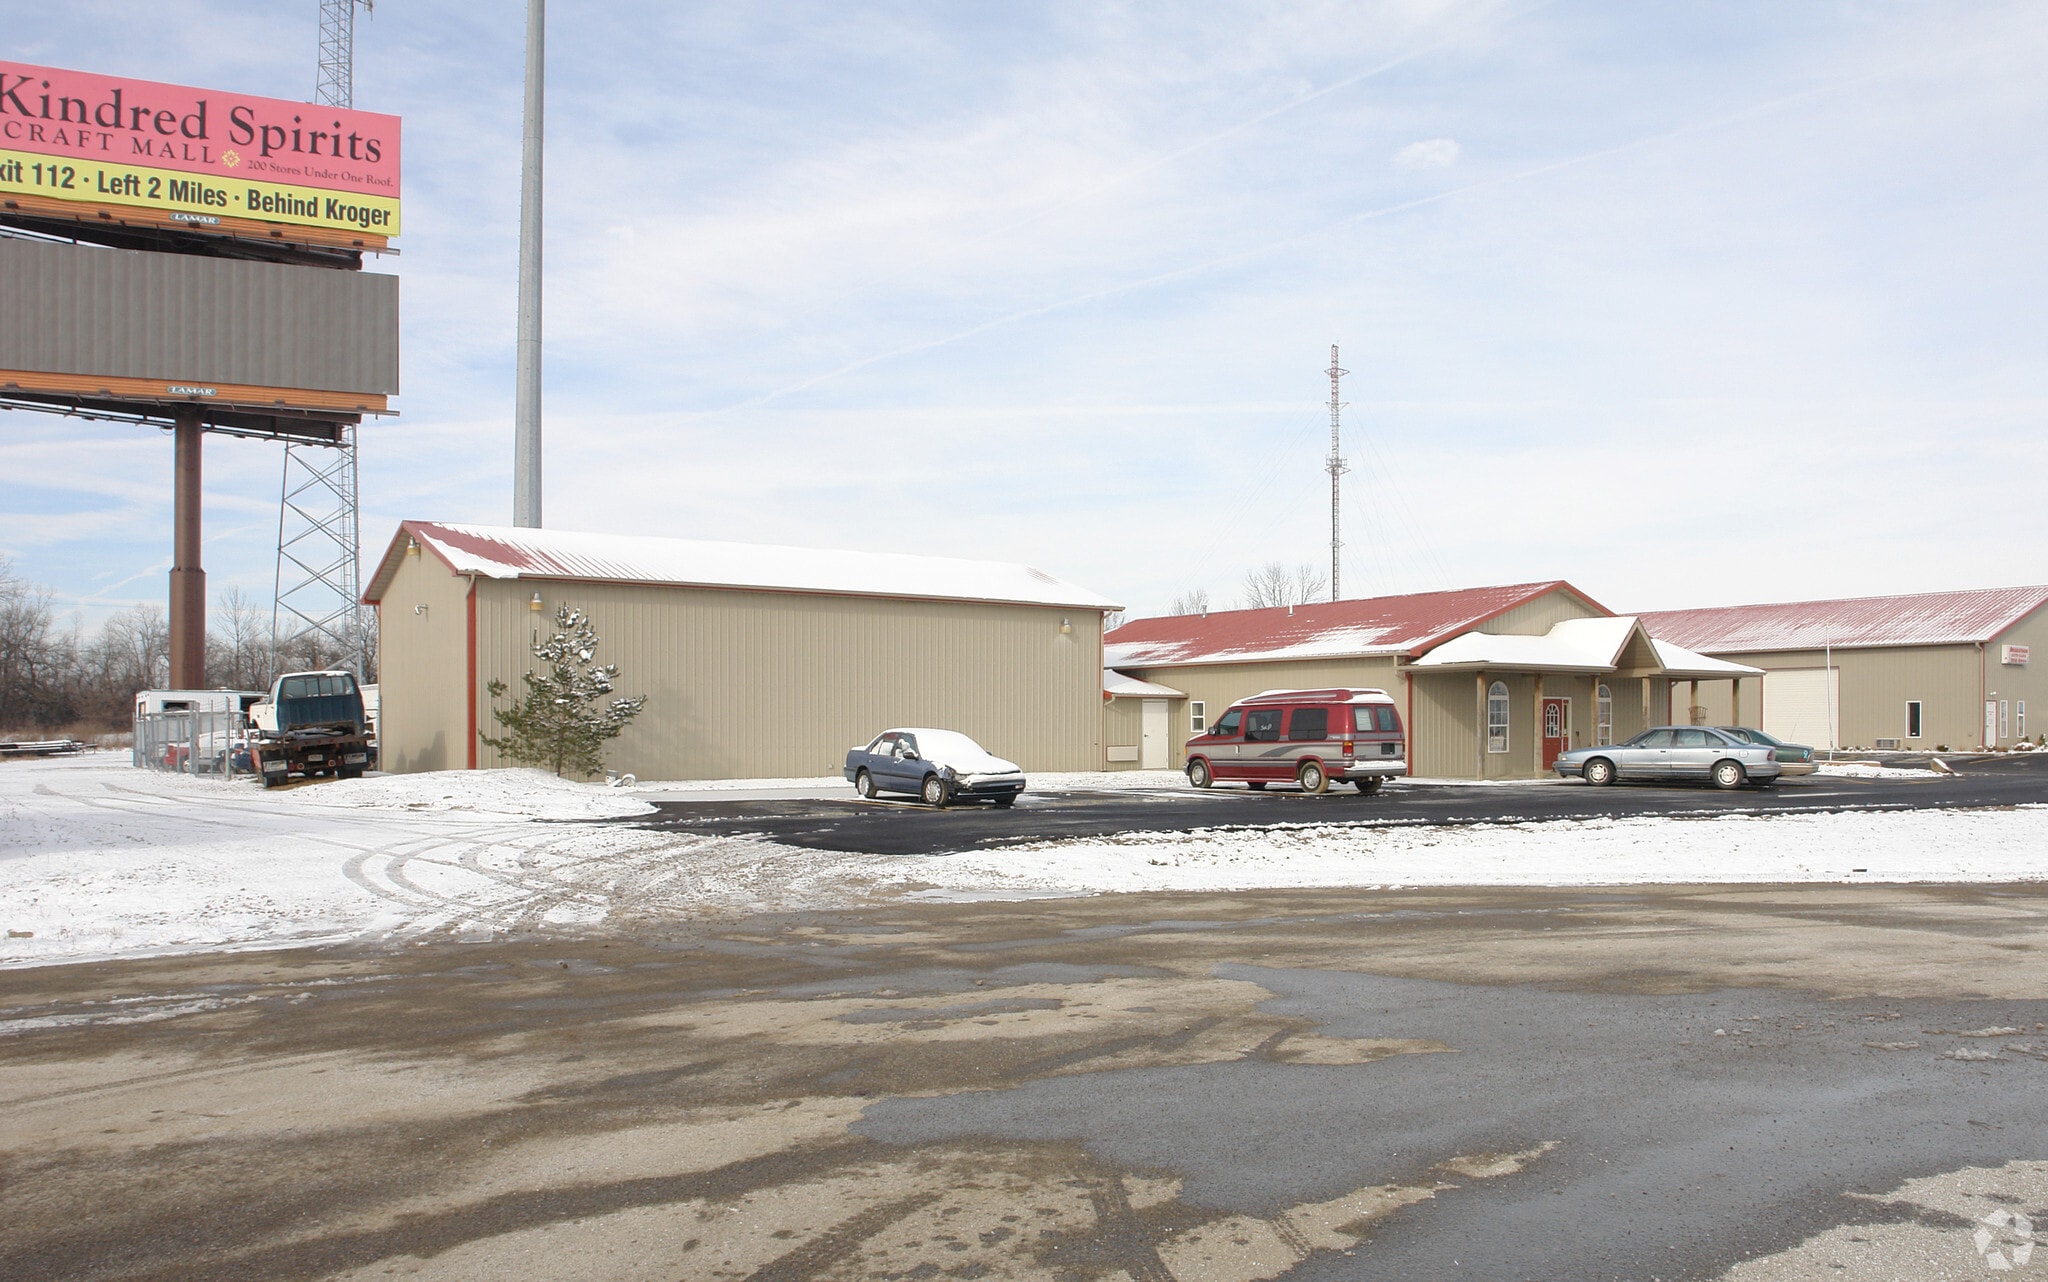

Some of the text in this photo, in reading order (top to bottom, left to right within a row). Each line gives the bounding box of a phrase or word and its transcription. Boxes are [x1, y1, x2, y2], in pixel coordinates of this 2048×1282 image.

[0, 73, 381, 163] Kindred Spirits
[4, 120, 216, 164] CRAFT MALL
[247, 159, 394, 188] 200 Stores Under One Roof.
[31, 162, 76, 190] 112
[97, 169, 141, 197] Left
[147, 176, 162, 200] 2
[168, 178, 227, 208] Miles
[247, 188, 318, 218] Behind
[325, 197, 392, 229] Kroger
[174, 213, 216, 224] LAMAR
[172, 386, 213, 395] LAMAR
